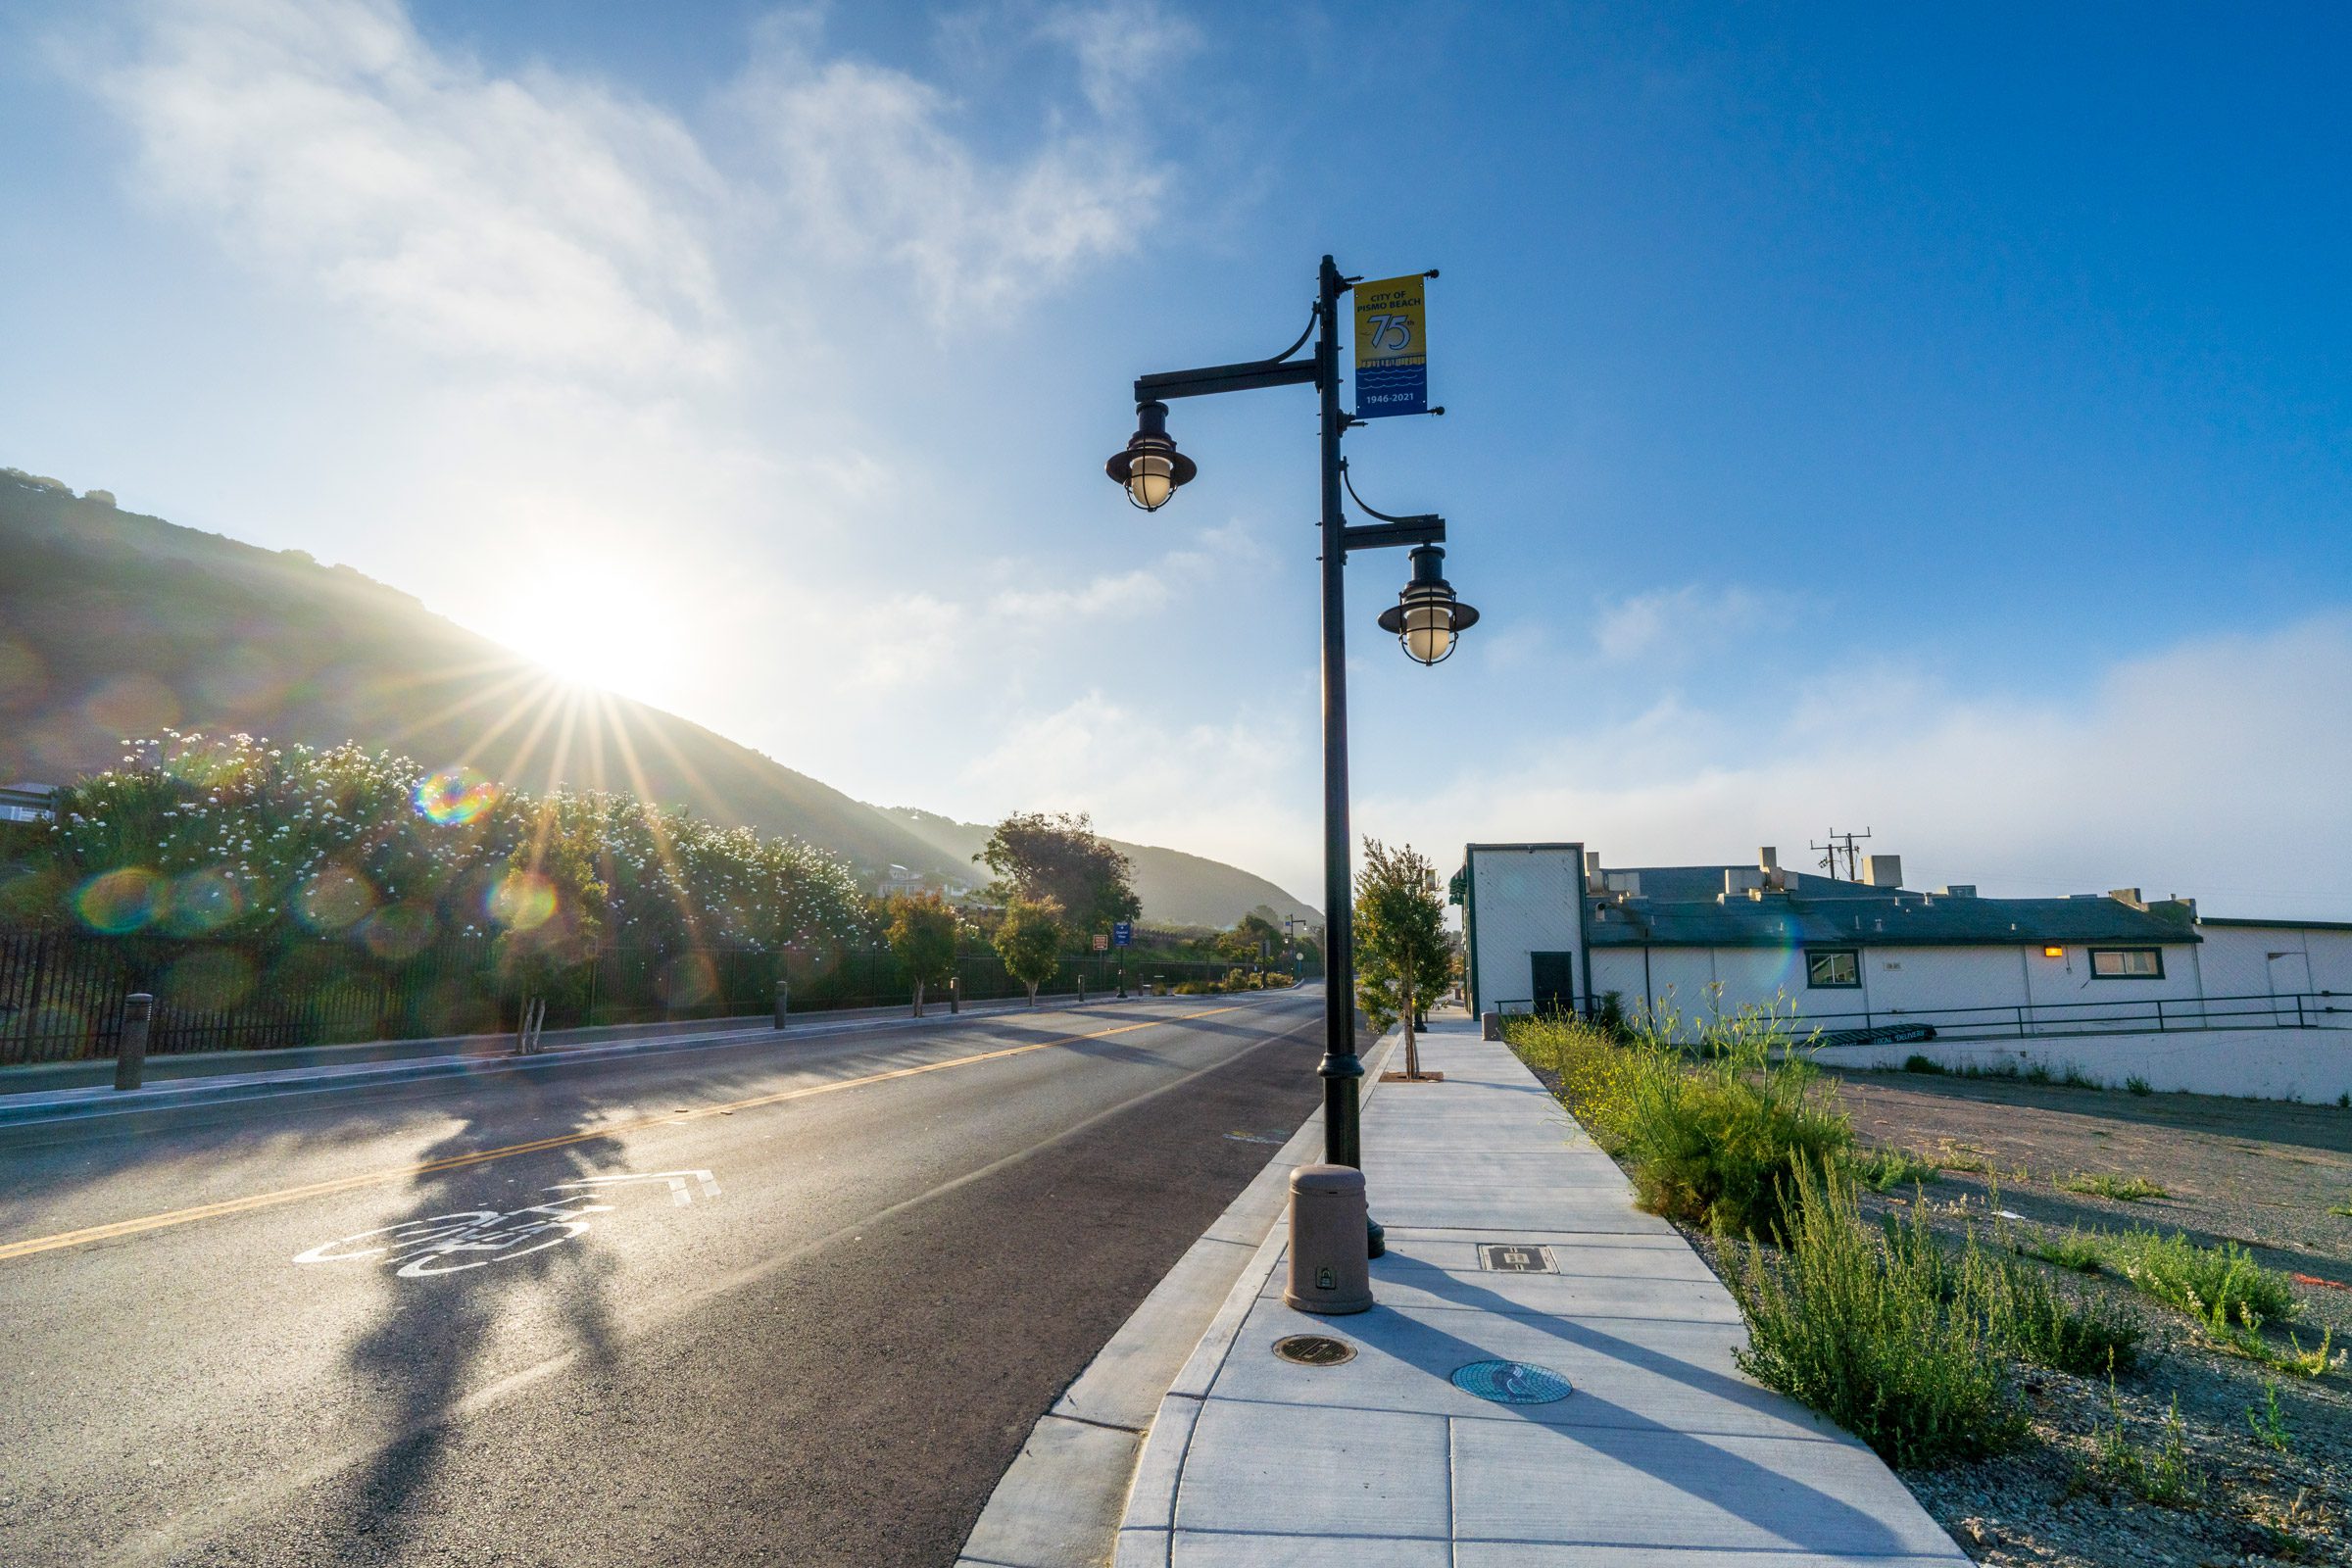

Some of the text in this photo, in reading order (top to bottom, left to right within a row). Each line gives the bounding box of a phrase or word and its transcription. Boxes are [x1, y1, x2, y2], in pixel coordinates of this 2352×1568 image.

[1370, 293, 1391, 302] CITY
[1357, 298, 1421, 313] PISMO BEACH
[1366, 393, 1414, 404] 1946-2021
